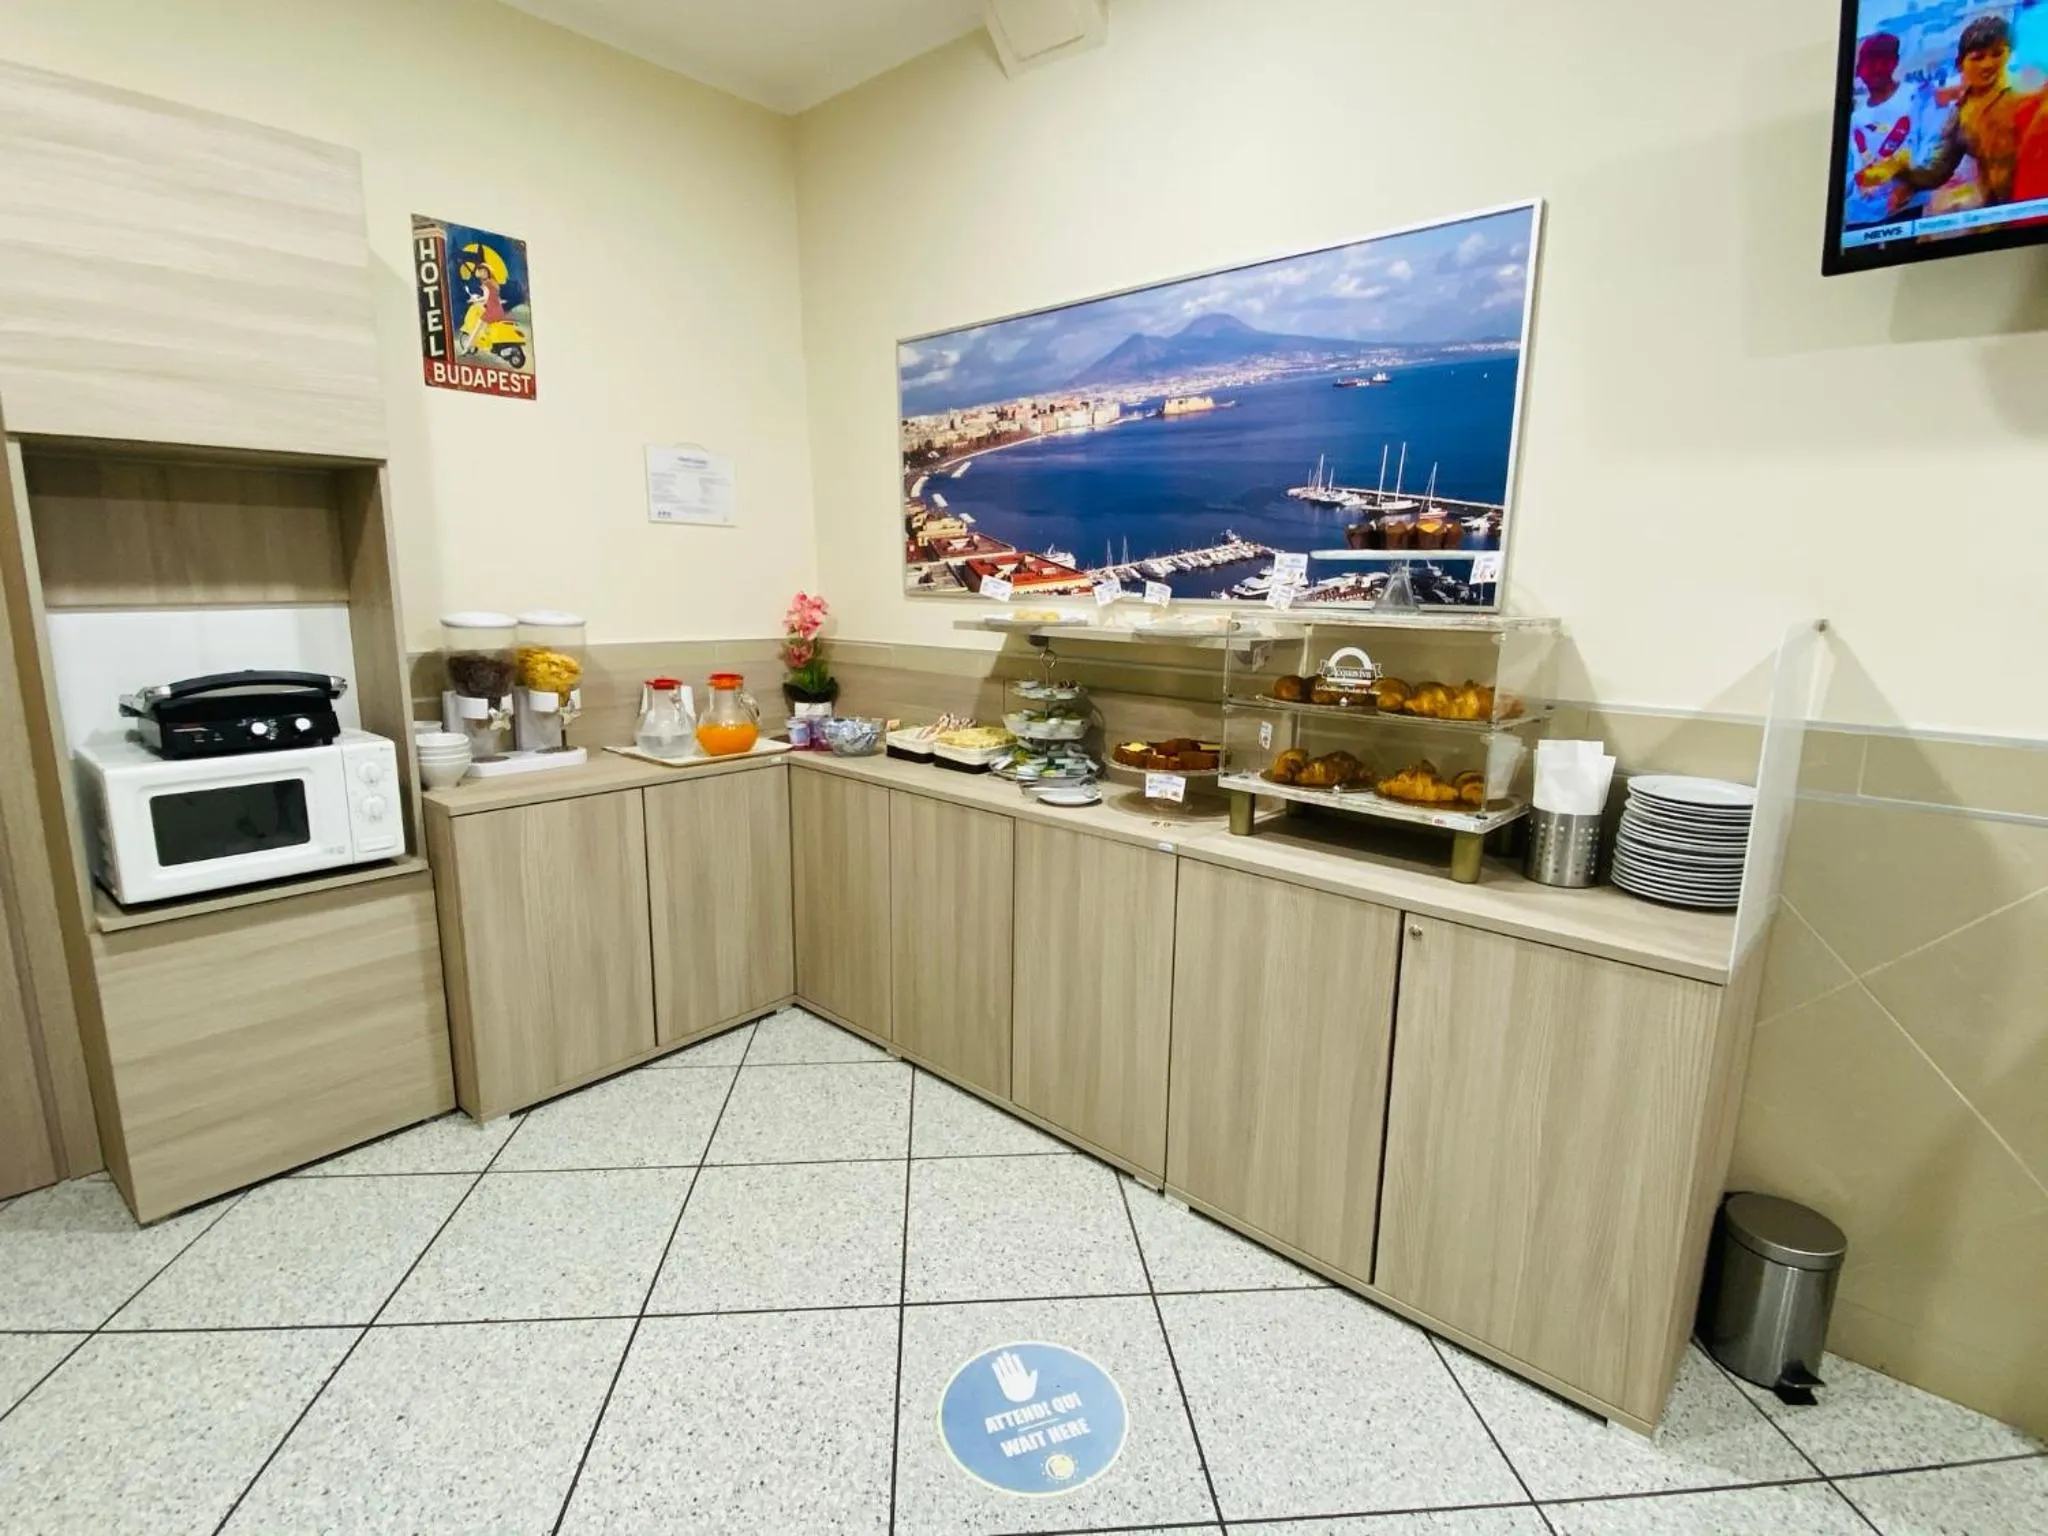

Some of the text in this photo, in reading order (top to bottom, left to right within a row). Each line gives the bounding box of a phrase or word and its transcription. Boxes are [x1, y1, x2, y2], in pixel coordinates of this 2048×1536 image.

[1863, 226, 1903, 241] NEWS
[419, 239, 444, 357] HOTEL
[433, 363, 531, 393] BUDAPEST
[985, 1393, 1082, 1433] ATTENDI QUI
[1001, 1418, 1091, 1457] WAIT HERE
